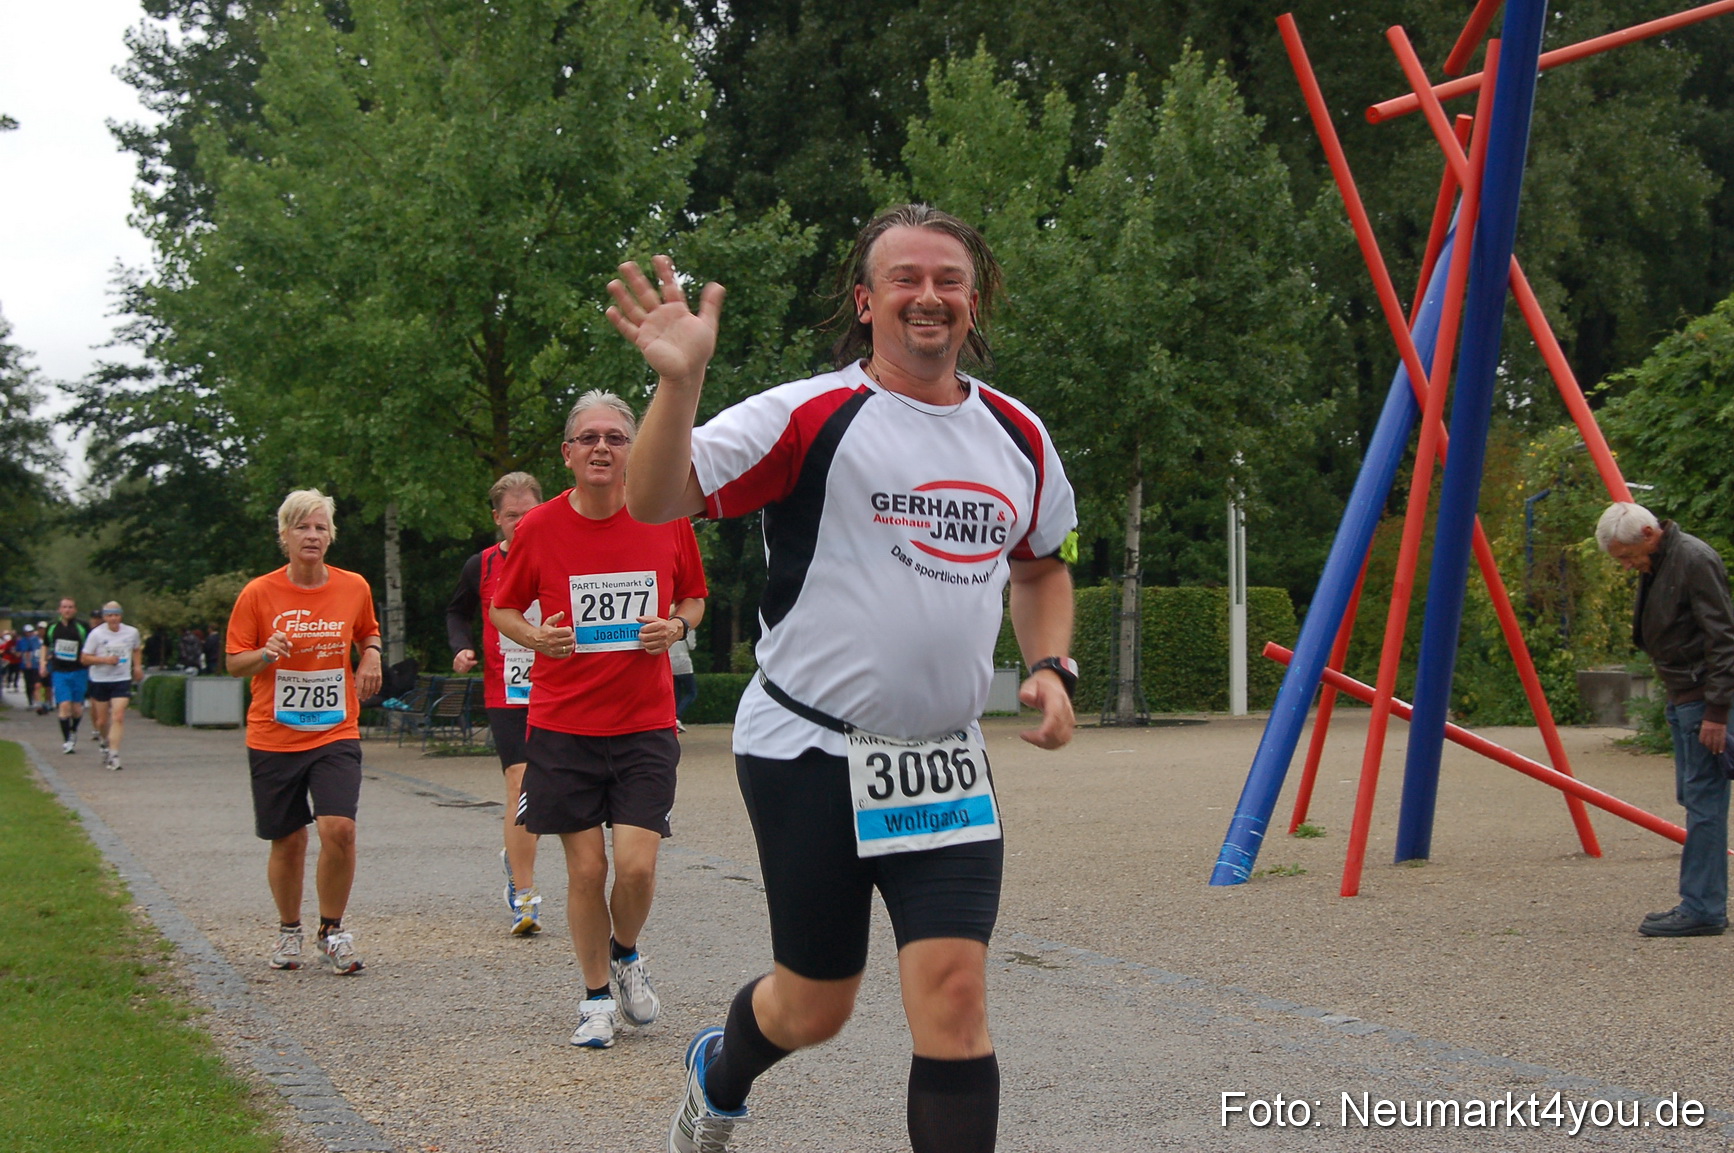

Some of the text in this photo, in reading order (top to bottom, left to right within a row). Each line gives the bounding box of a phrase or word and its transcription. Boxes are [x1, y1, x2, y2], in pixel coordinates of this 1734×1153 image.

[870, 492, 1006, 522] GERHART &
[873, 513, 931, 529] Autohaus
[930, 520, 1006, 545] JÄNIG
[891, 545, 914, 567] Das
[914, 561, 970, 585] sportliche
[571, 580, 642, 591] PARTL Neumarkt
[580, 591, 650, 623] 2877
[285, 619, 346, 632] Fischer
[593, 627, 640, 642] Joachim
[277, 675, 333, 684] PARTL Neumarkt
[282, 685, 339, 708] 2785
[299, 713, 321, 723] Gabi
[866, 747, 977, 800] 3006
[884, 808, 971, 834] Wolfgang
